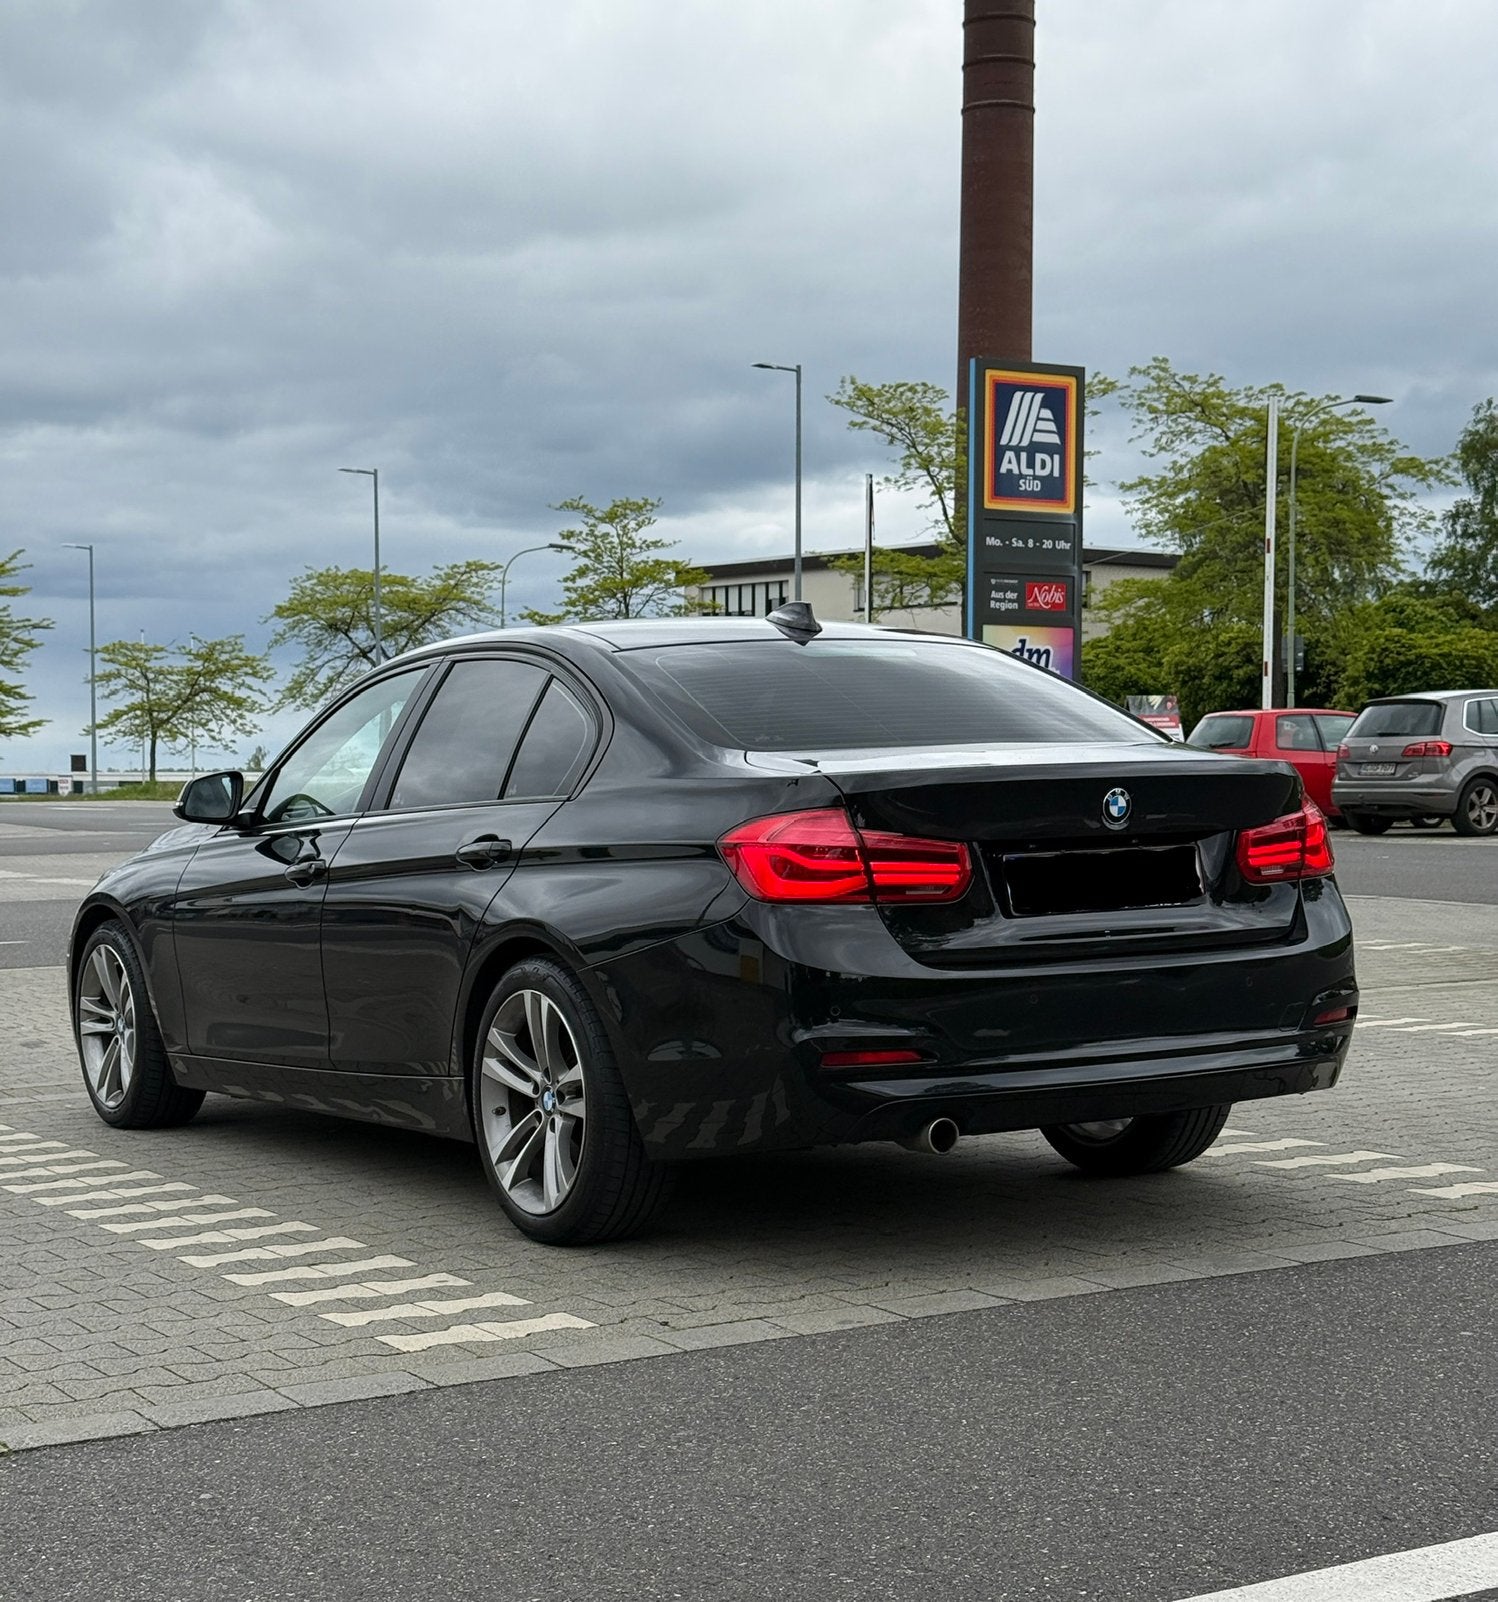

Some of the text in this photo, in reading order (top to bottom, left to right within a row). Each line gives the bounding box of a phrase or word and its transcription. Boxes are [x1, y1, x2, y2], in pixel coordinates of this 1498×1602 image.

[1000, 450, 1060, 477] ALDI
[1019, 476, 1041, 491] SÜD
[985, 536, 1003, 547] Mo.
[1011, 537, 1025, 548] Sa.
[1027, 538, 1034, 549] 8
[1042, 539, 1053, 549] 20
[1055, 540, 1071, 550] Uhr
[990, 590, 1018, 599] Aus der
[1027, 585, 1064, 609] Nobis
[990, 600, 1018, 611] Region
